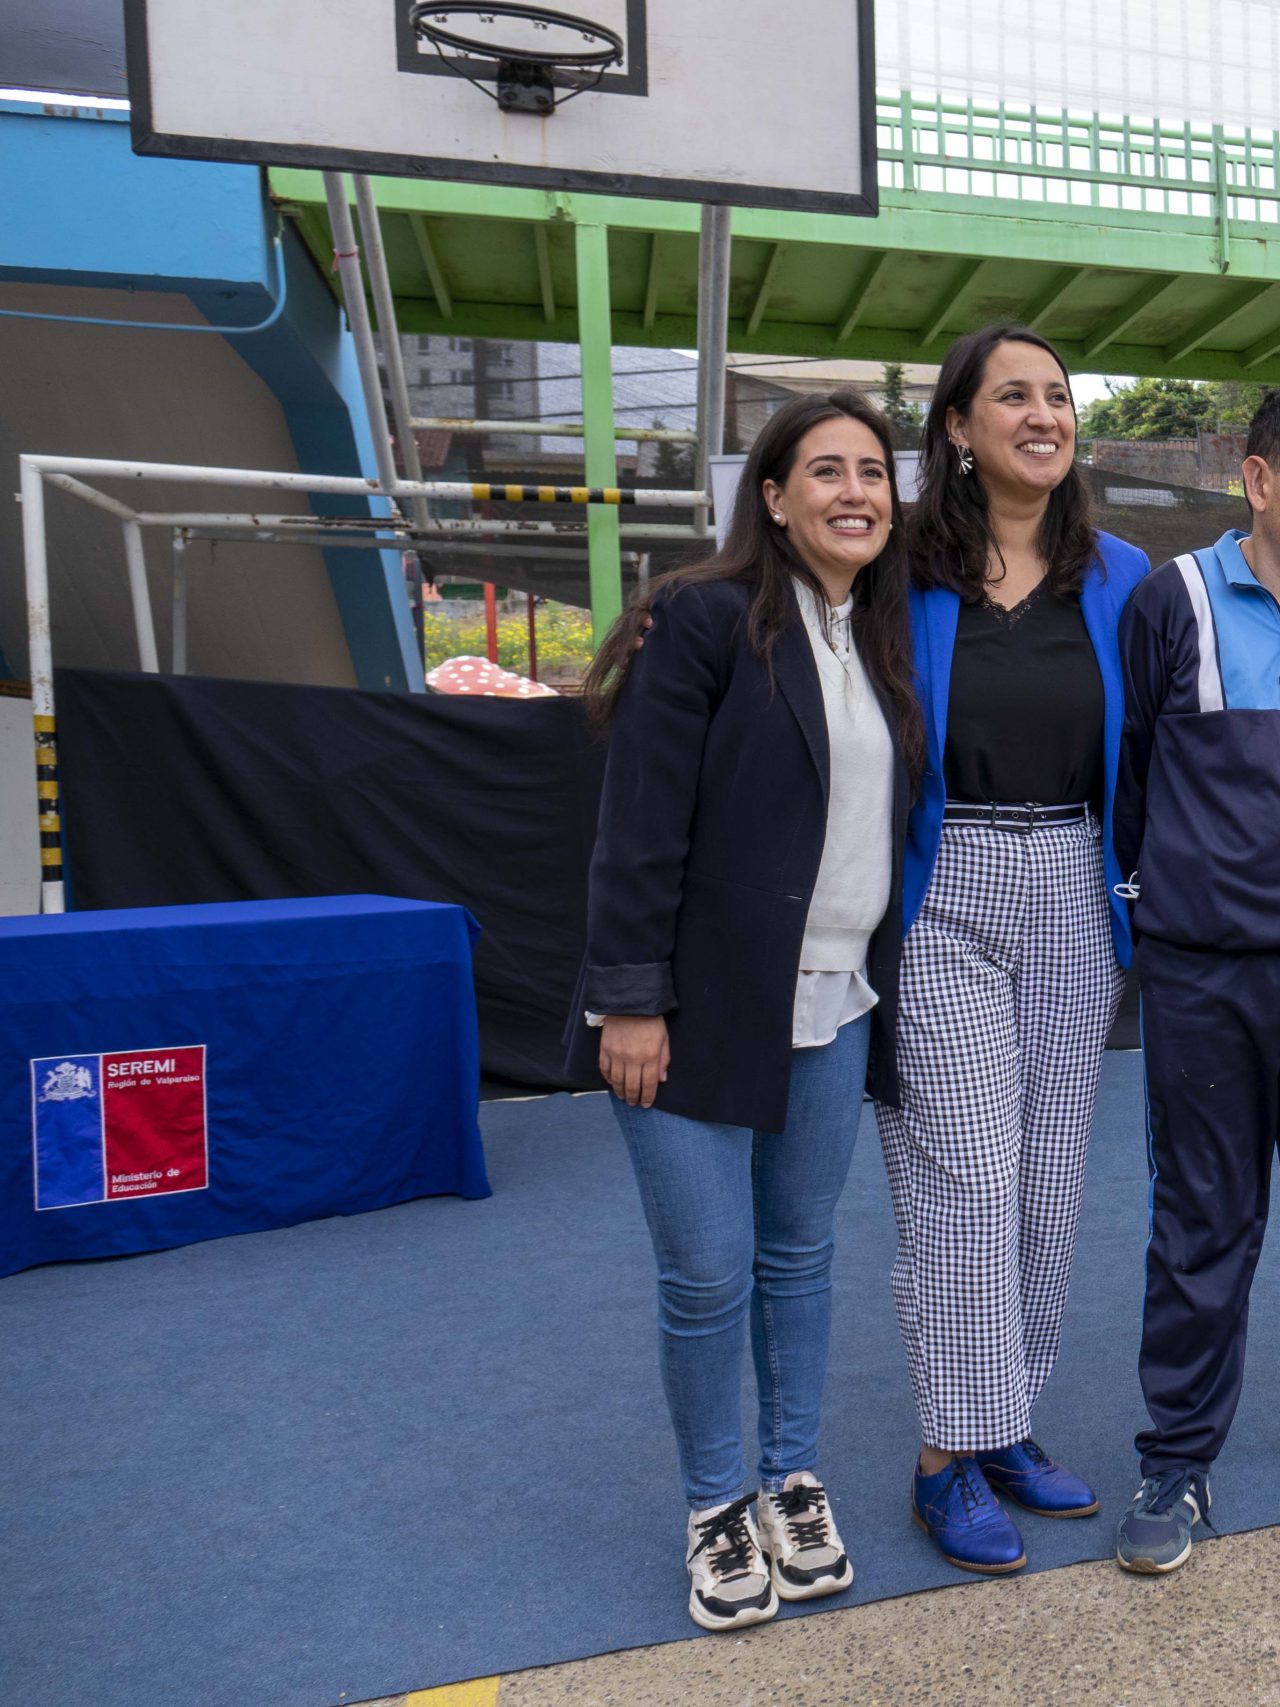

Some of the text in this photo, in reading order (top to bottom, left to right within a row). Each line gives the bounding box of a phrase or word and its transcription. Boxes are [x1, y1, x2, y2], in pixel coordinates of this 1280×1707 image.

[107, 1059, 176, 1077] SEREMI
[108, 1079, 137, 1089] Región
[140, 1078, 151, 1086] de
[112, 1168, 180, 1184] Ministerio de
[112, 1181, 157, 1193] Educación
